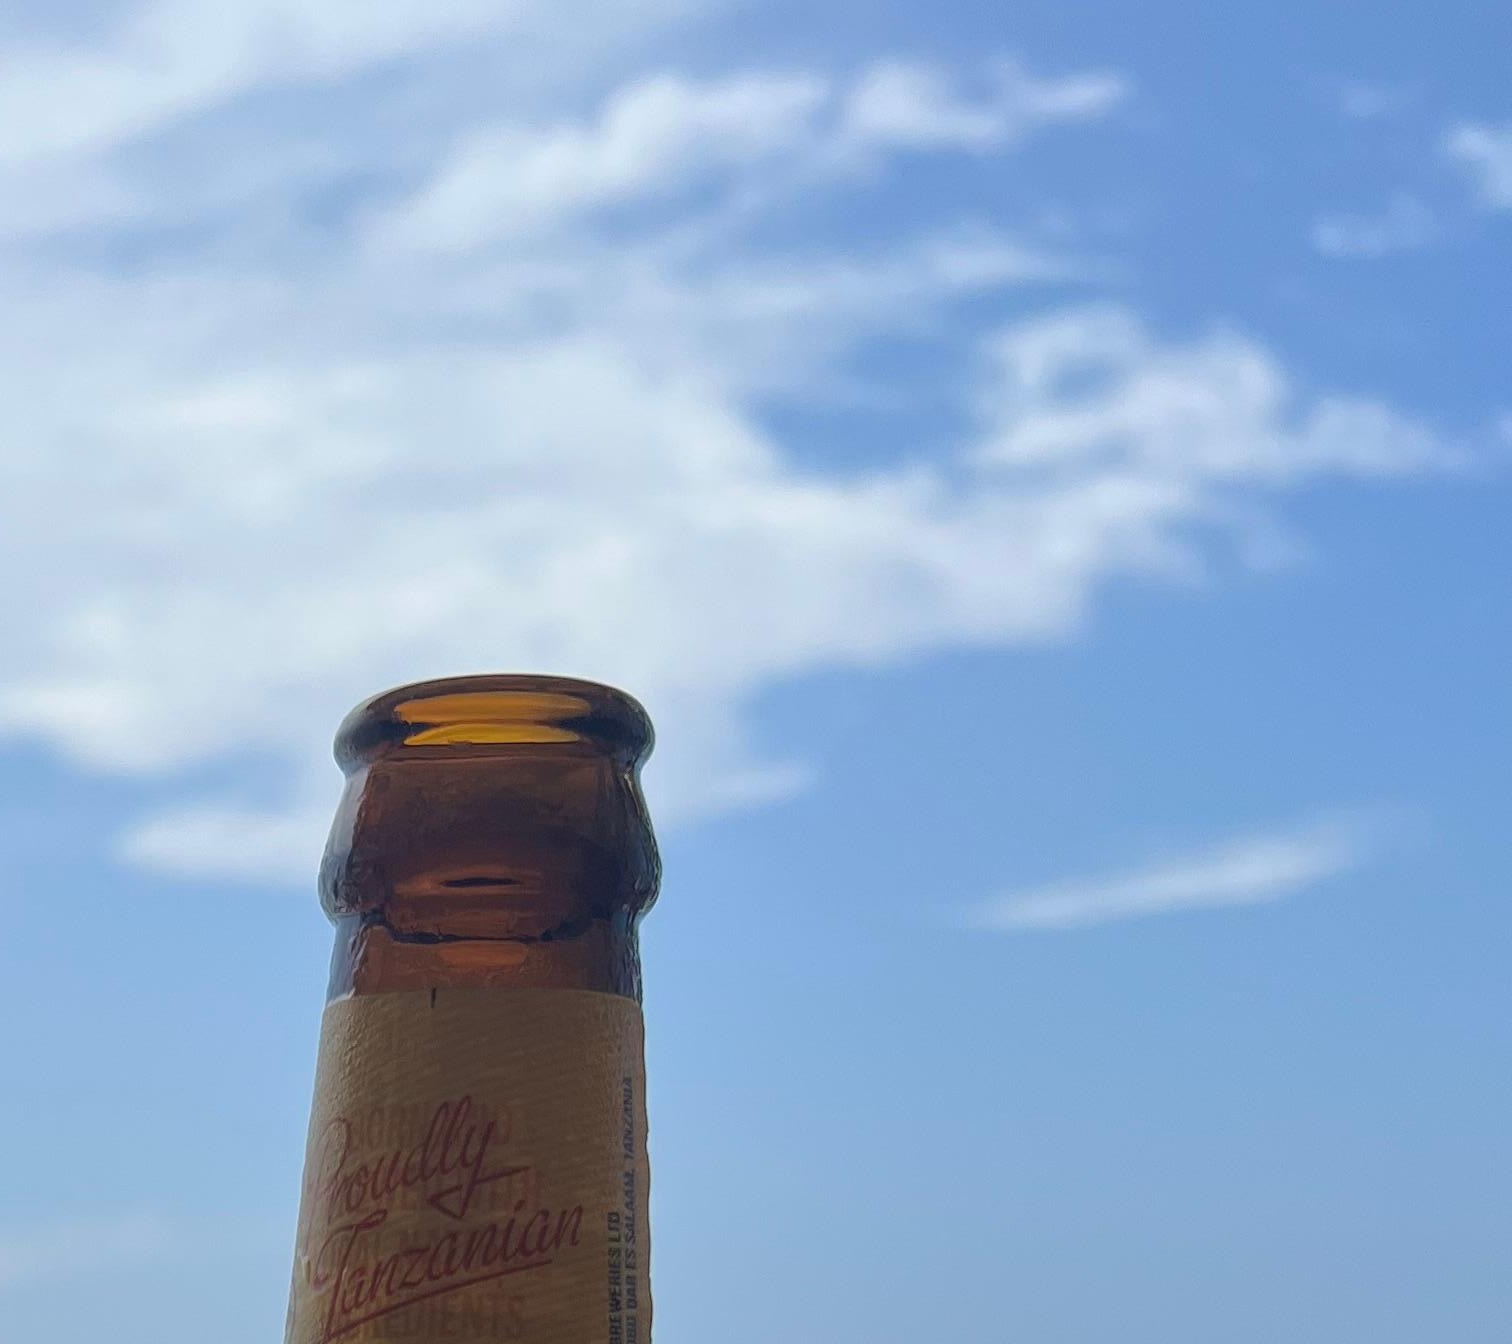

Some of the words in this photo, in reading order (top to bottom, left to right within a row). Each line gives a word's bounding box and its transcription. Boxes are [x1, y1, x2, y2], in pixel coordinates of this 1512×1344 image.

[623, 1076, 635, 1159] TANZANIA
[306, 1095, 530, 1240] Proudly
[607, 1212, 620, 1243] LTD
[625, 1247, 636, 1269] ES
[625, 1275, 637, 1309] DAR
